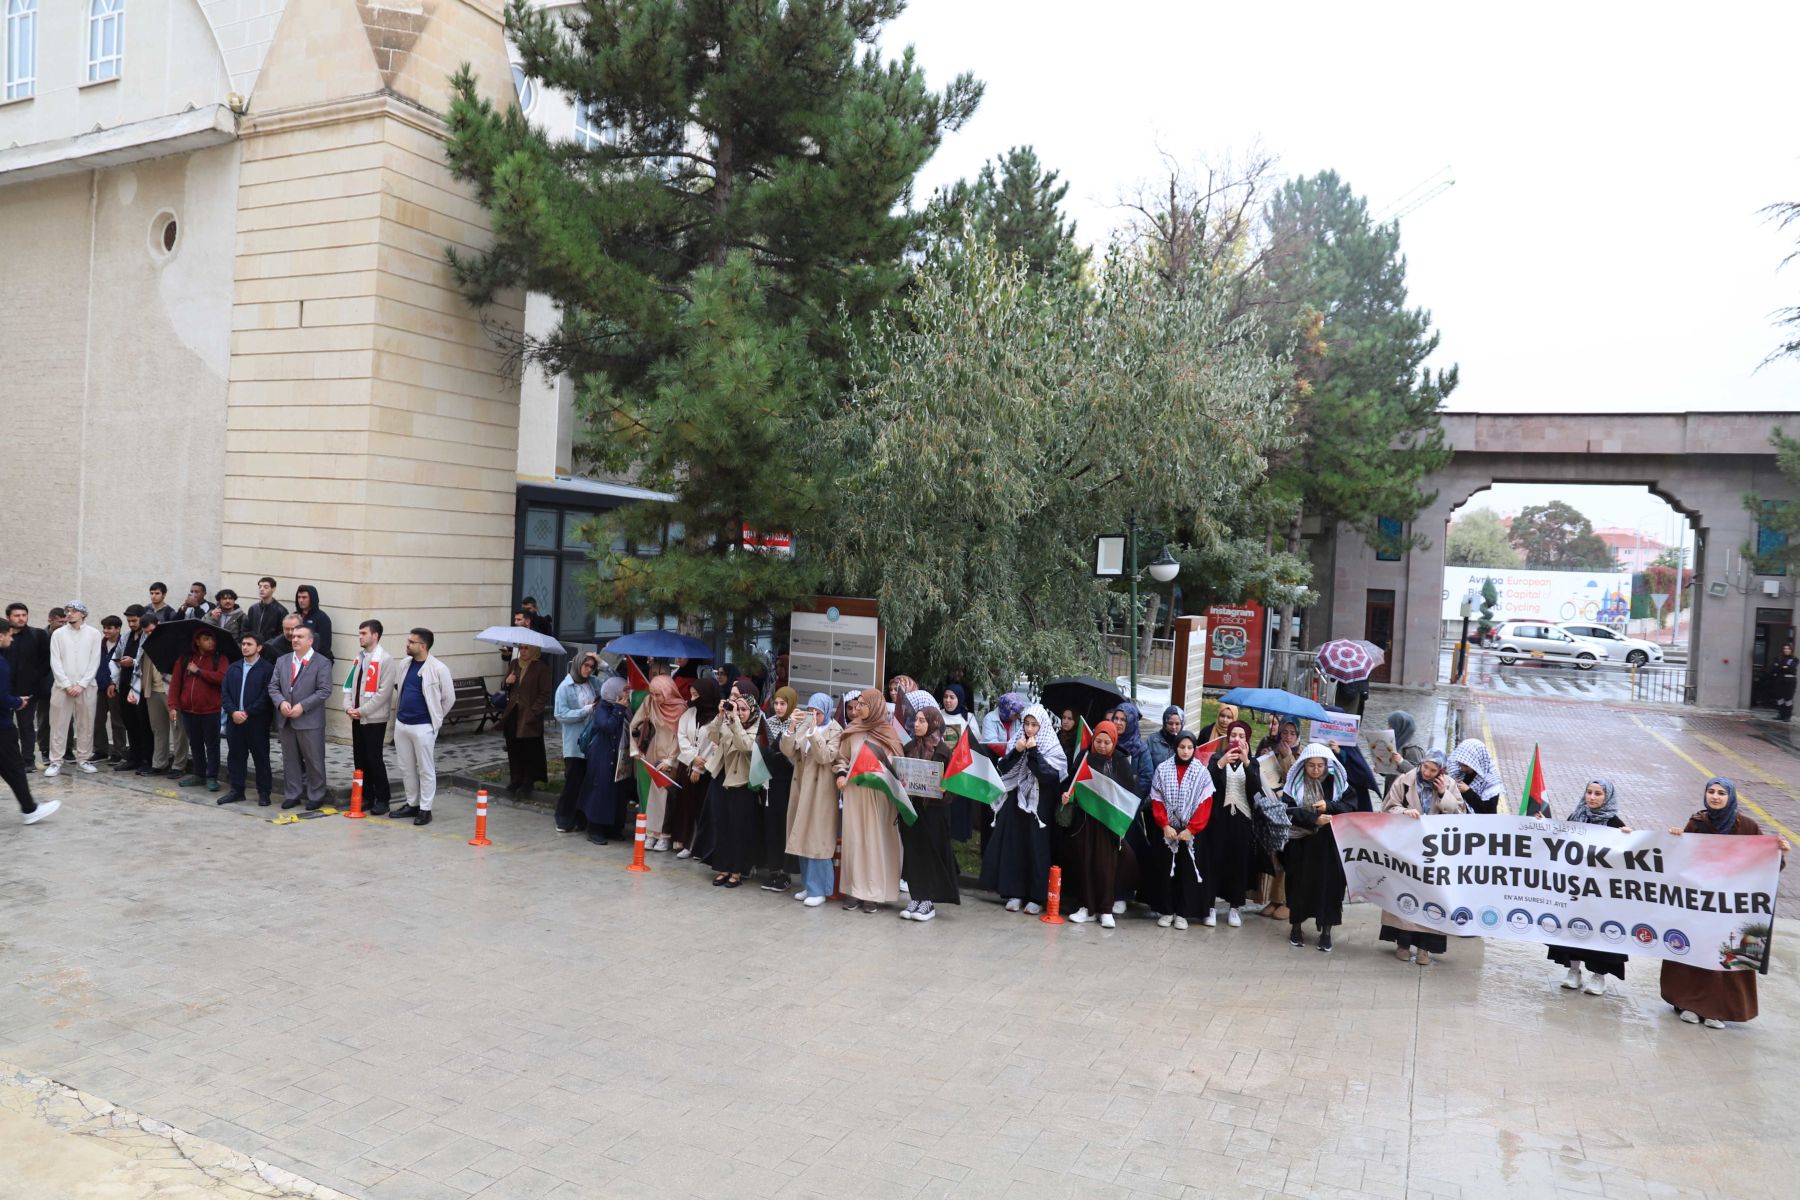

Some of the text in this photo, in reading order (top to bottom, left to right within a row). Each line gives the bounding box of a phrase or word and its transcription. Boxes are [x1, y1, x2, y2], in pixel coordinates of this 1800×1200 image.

[1469, 575, 1551, 587] Avrpa European
[1506, 589, 1541, 599] Capital
[1505, 602, 1540, 613] Cycling
[1422, 827, 1532, 864] ŞÜPHE
[1543, 838, 1613, 869] YOK
[1457, 865, 1602, 901] KURTULUŞA
[1609, 878, 1772, 915] EREMEZLER
[1554, 900, 1567, 909] AYET
